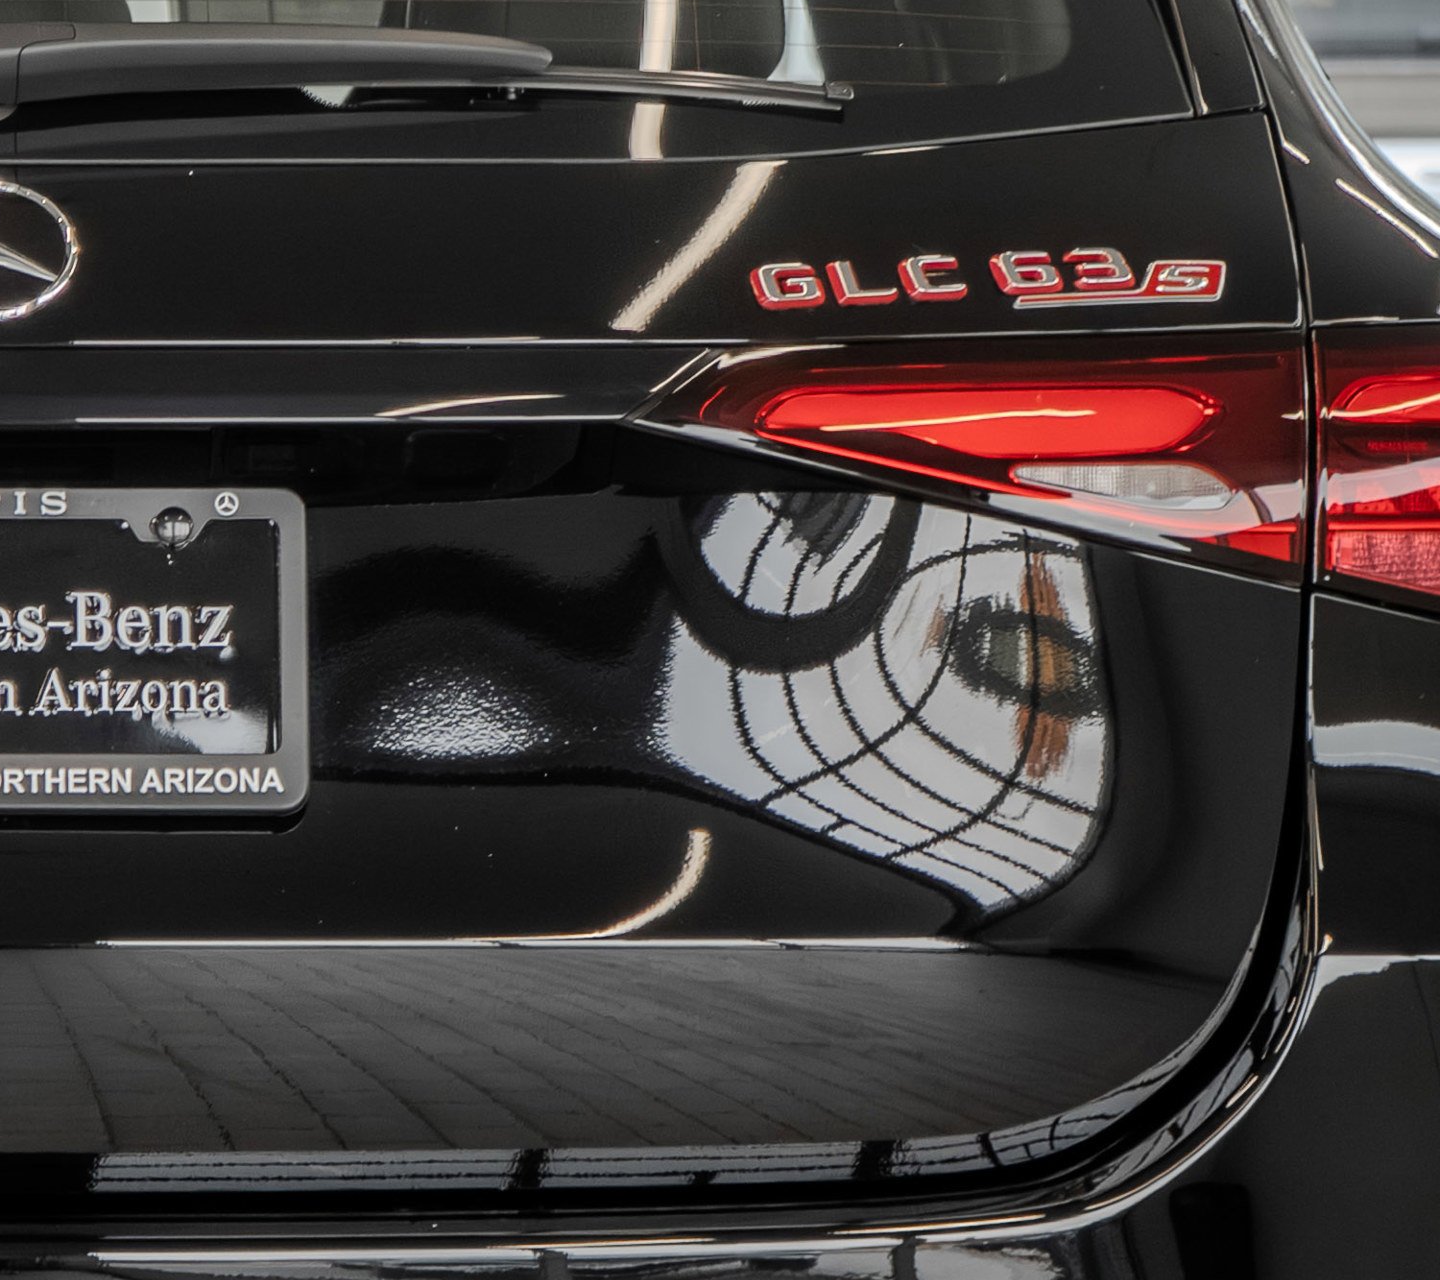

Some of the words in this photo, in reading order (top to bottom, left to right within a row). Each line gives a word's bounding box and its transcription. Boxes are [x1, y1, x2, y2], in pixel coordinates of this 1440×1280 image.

[749, 254, 968, 311] GLC
[34, 668, 231, 717] Arizona
[138, 766, 286, 795] ARIZONA
